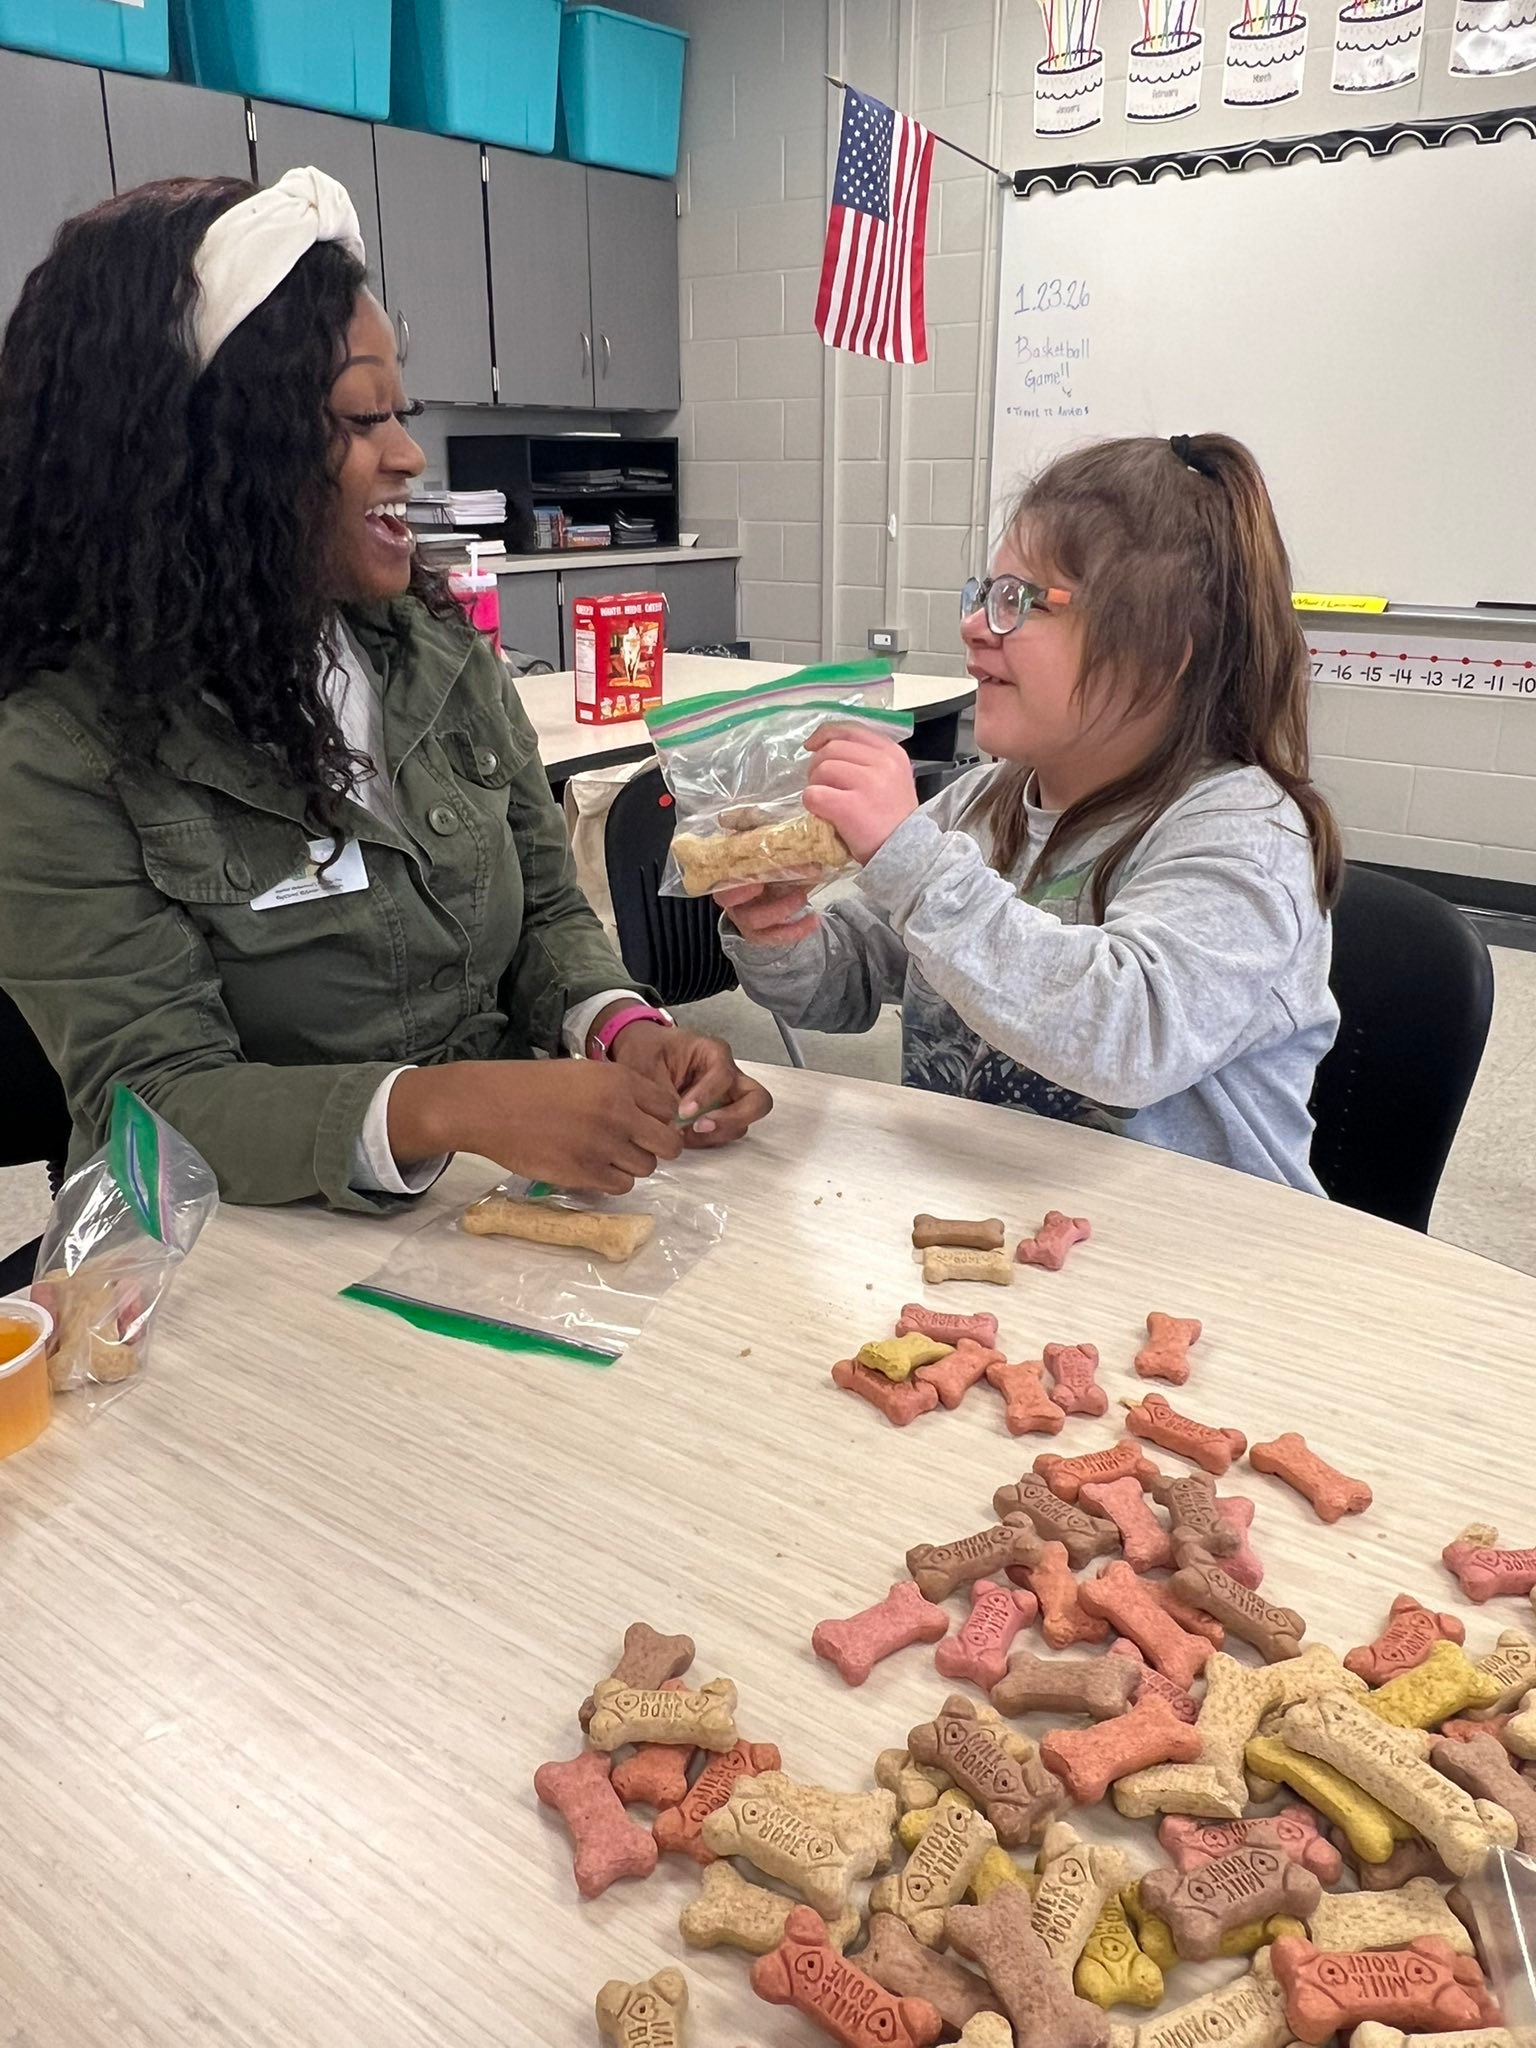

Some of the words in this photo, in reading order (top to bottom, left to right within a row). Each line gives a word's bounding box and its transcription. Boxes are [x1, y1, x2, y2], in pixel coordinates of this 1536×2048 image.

[1014, 279, 1091, 315] 1.23.26
[1015, 335, 1090, 364] Basketball
[1330, 665, 1352, 680] -16
[1360, 666, 1383, 682] -15
[1389, 668, 1413, 685] -14
[1420, 670, 1444, 686] -13
[1451, 673, 1476, 690] -12
[1483, 675, 1504, 692] -11
[1511, 676, 1536, 693] -10
[639, 1702, 683, 1719] BONE
[953, 1744, 995, 1786] BONE
[967, 1733, 1007, 1769] MILK
[758, 1820, 807, 1857] BONE
[913, 1822, 952, 1874] BONE
[930, 1833, 969, 1887] MILK
[1046, 1888, 1085, 1944] BONE
[824, 1960, 879, 2012] BONE
[1350, 1975, 1410, 1998] MILK
[811, 1983, 867, 2035] MILK
